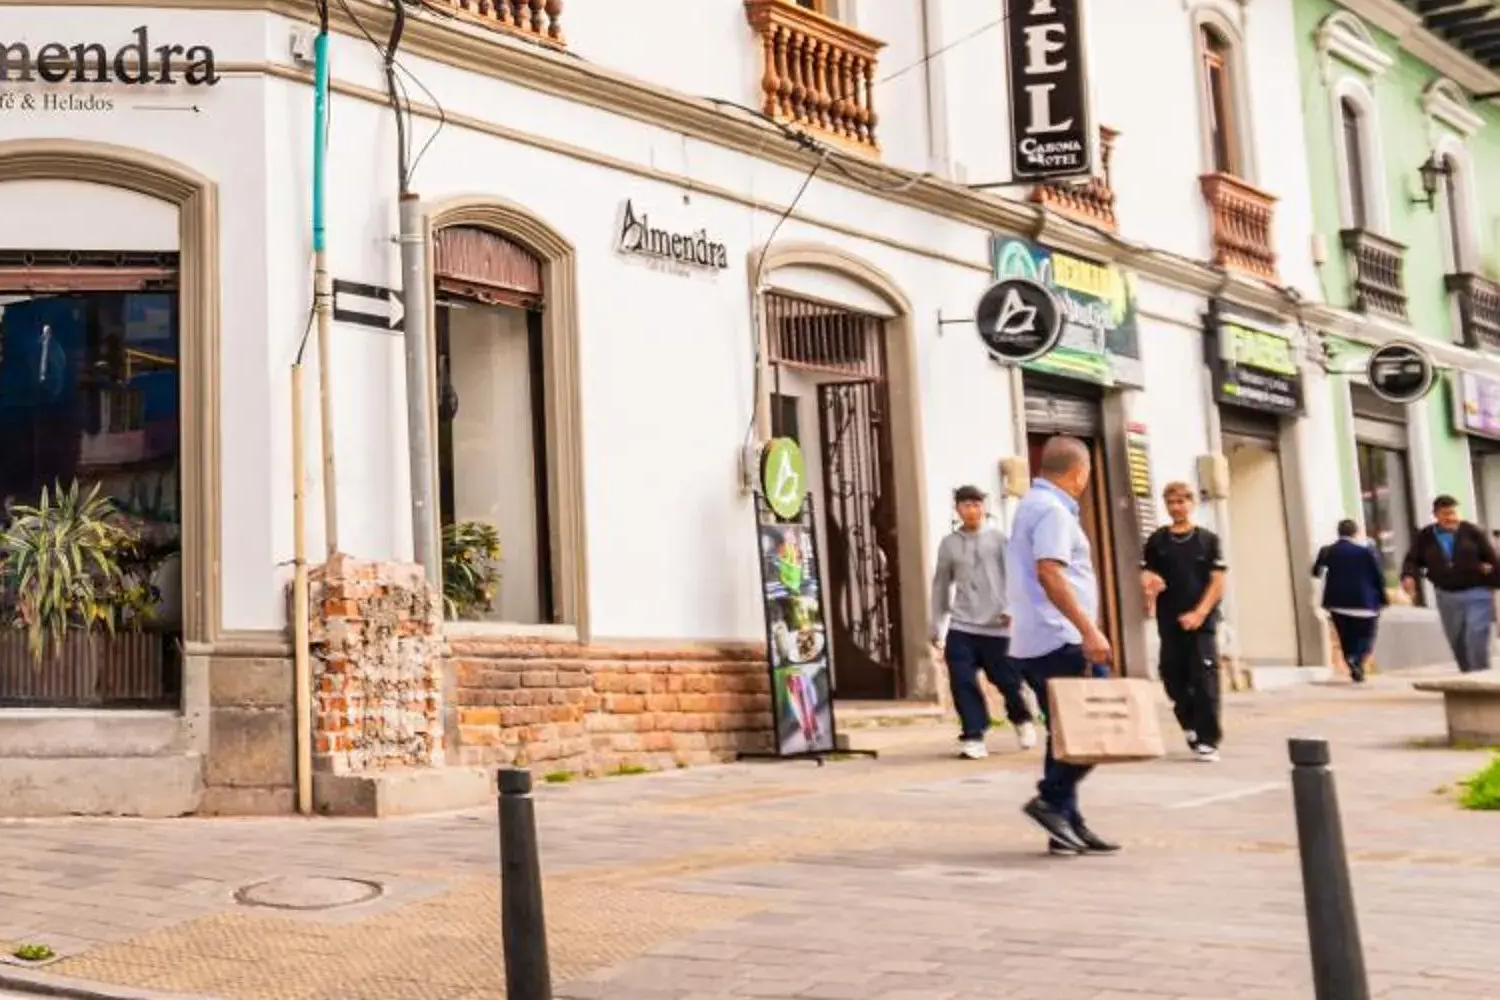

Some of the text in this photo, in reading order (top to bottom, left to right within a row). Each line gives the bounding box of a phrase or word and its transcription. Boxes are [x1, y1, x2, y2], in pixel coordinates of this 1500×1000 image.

[21, 92, 36, 111] &
[43, 92, 115, 112] Helados
[621, 198, 728, 268] Almendra
